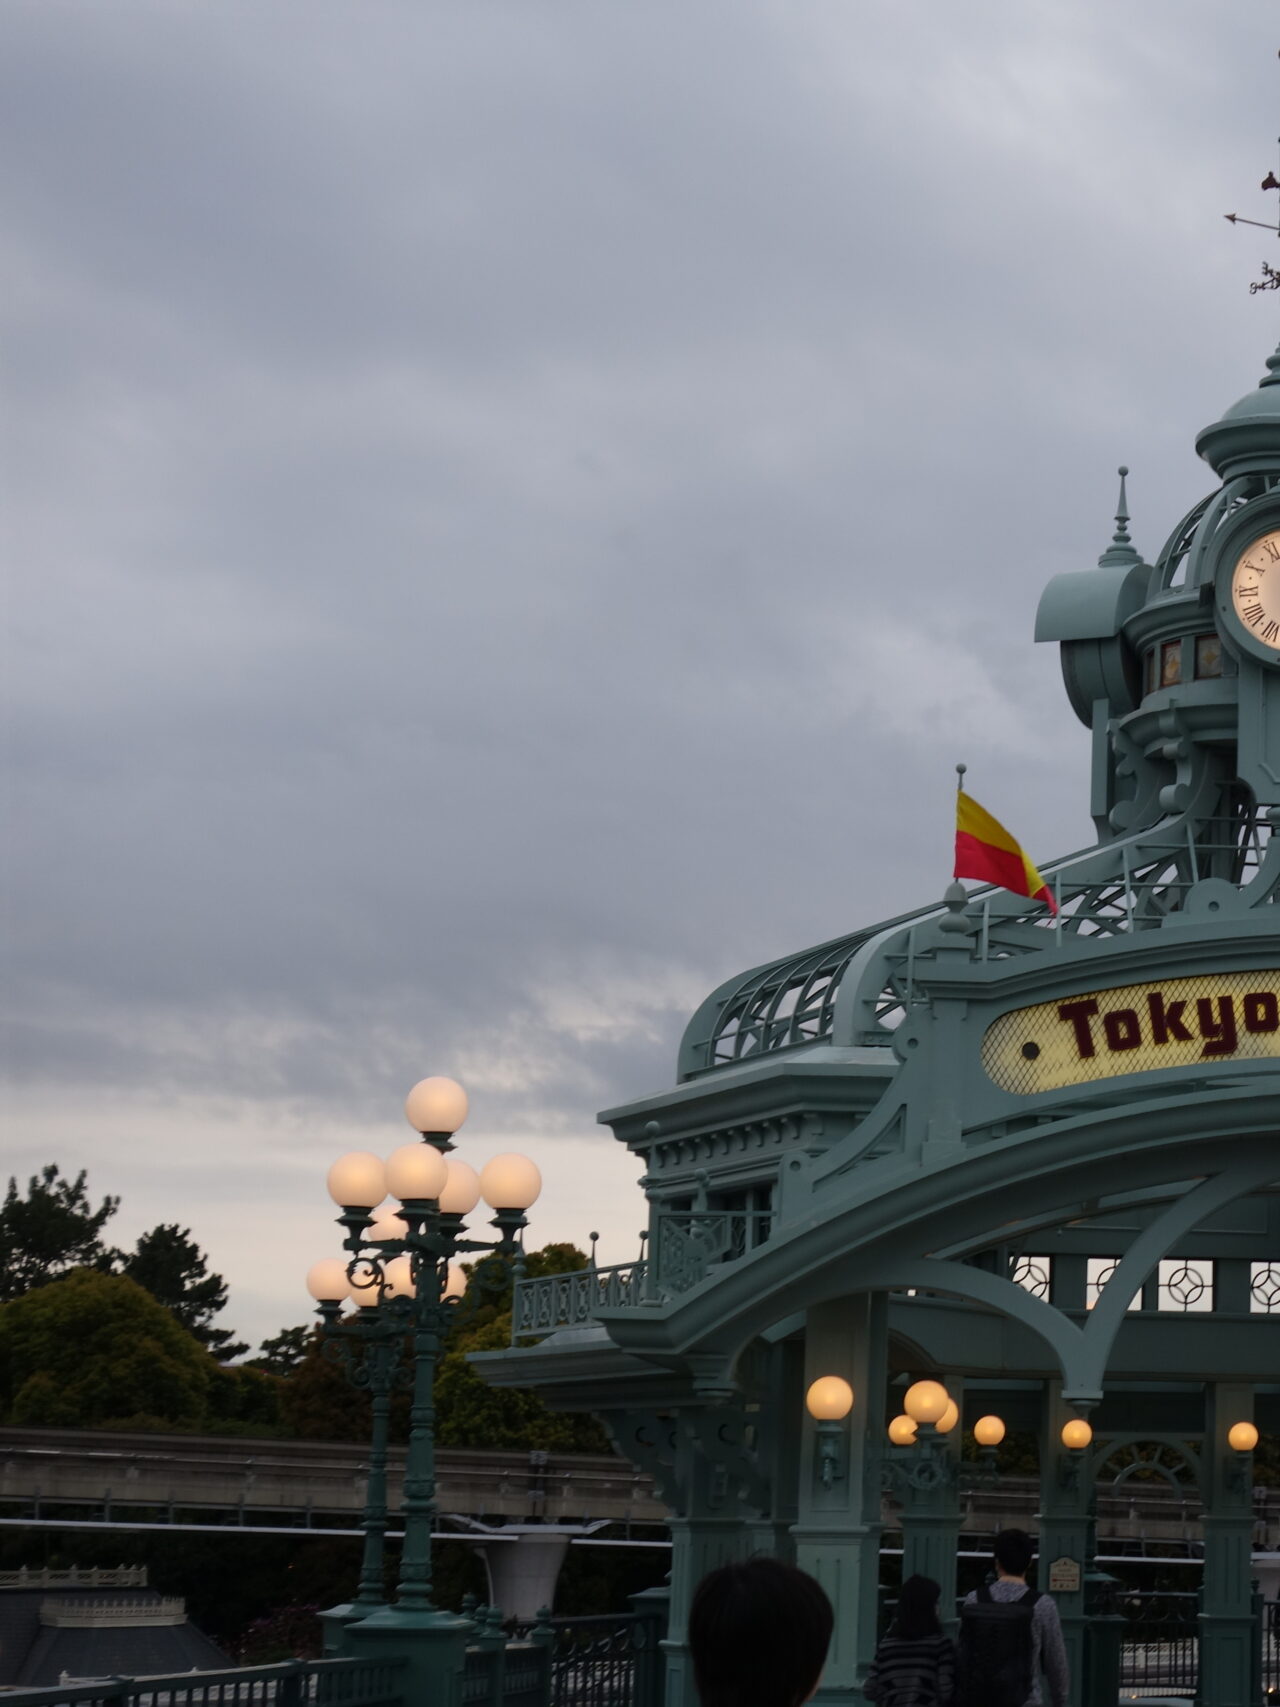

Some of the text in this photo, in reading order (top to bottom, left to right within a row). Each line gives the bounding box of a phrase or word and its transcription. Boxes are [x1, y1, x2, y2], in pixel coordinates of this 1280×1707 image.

[1262, 541, 1280, 563] XI
[1245, 560, 1265, 577] X
[1239, 585, 1258, 598] IX
[1242, 603, 1265, 627] VIII
[1261, 620, 1280, 642] VII
[1058, 992, 1279, 1060] Tokyo
